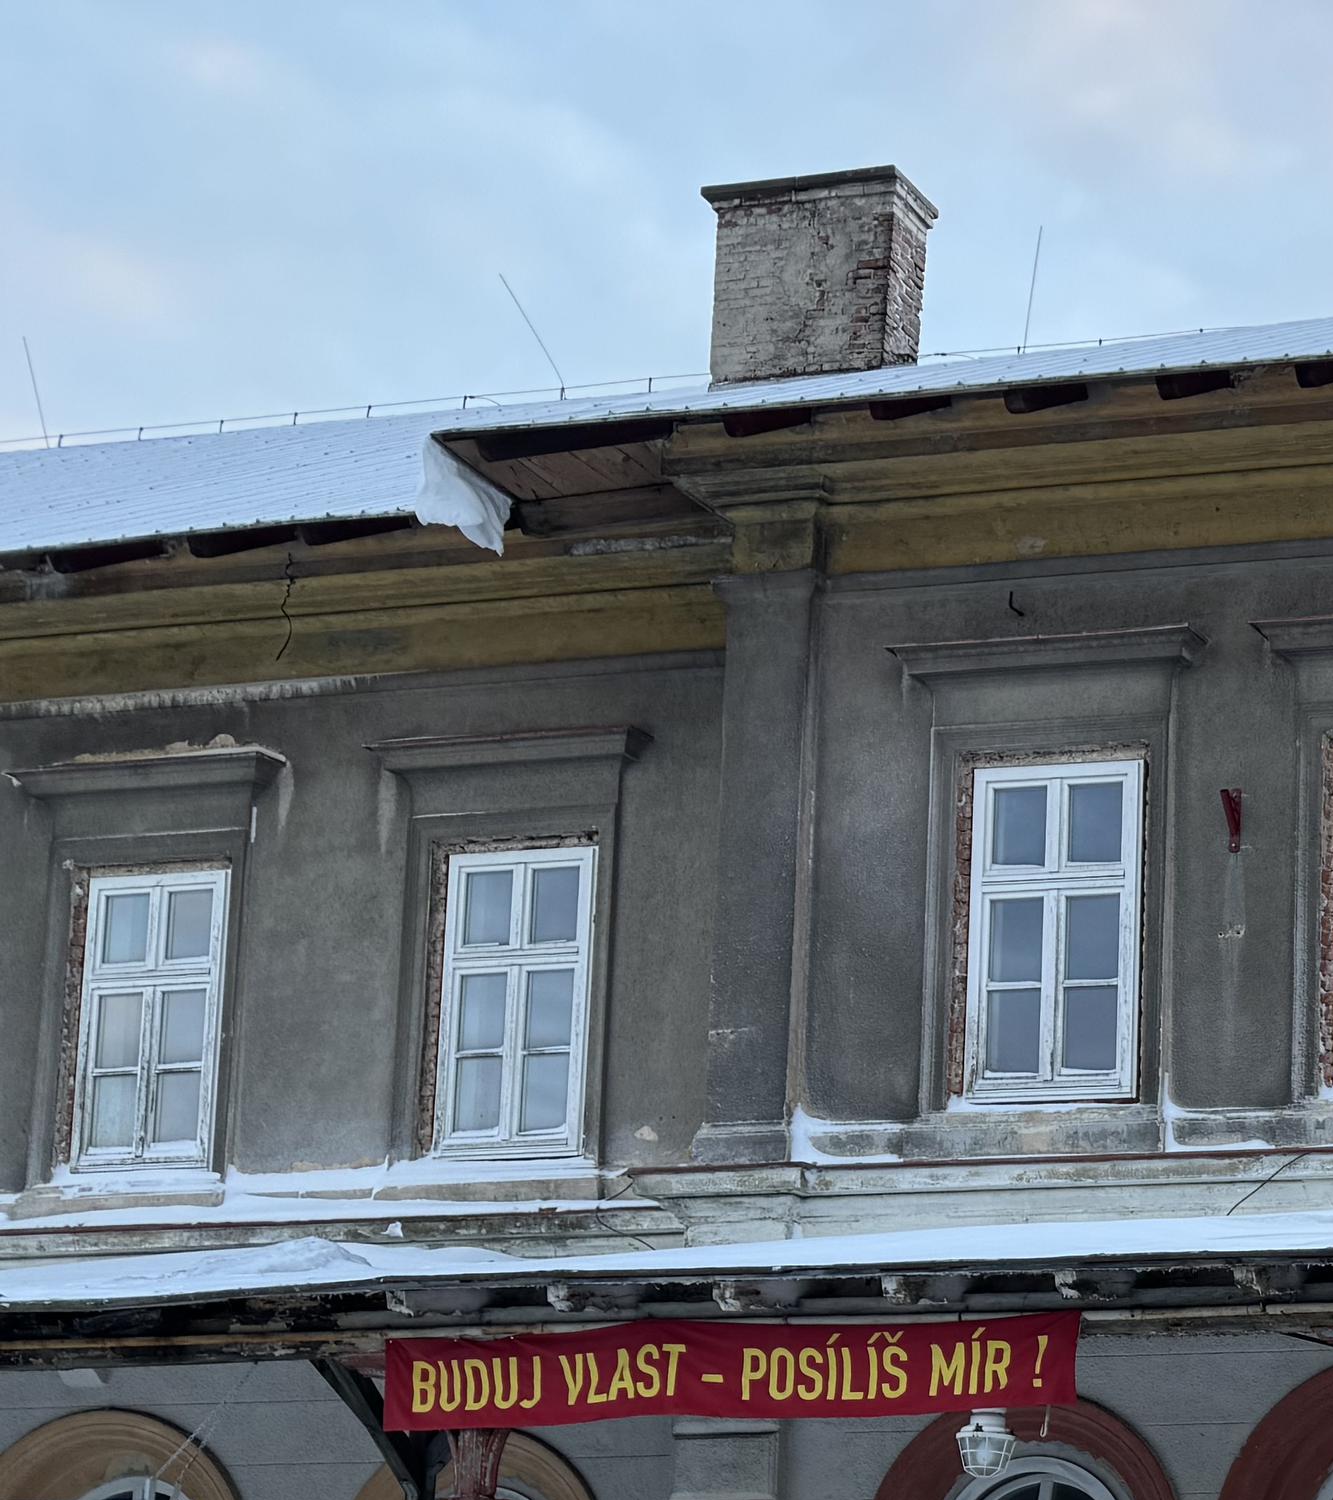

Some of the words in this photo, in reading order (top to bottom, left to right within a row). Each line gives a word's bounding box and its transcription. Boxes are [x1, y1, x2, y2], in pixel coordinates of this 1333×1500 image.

[411, 1356, 542, 1414] BUDUJ
[558, 1343, 687, 1406] VLAST
[741, 1330, 909, 1403] POSÍLÍŠ
[928, 1327, 1012, 1398] MÍR
